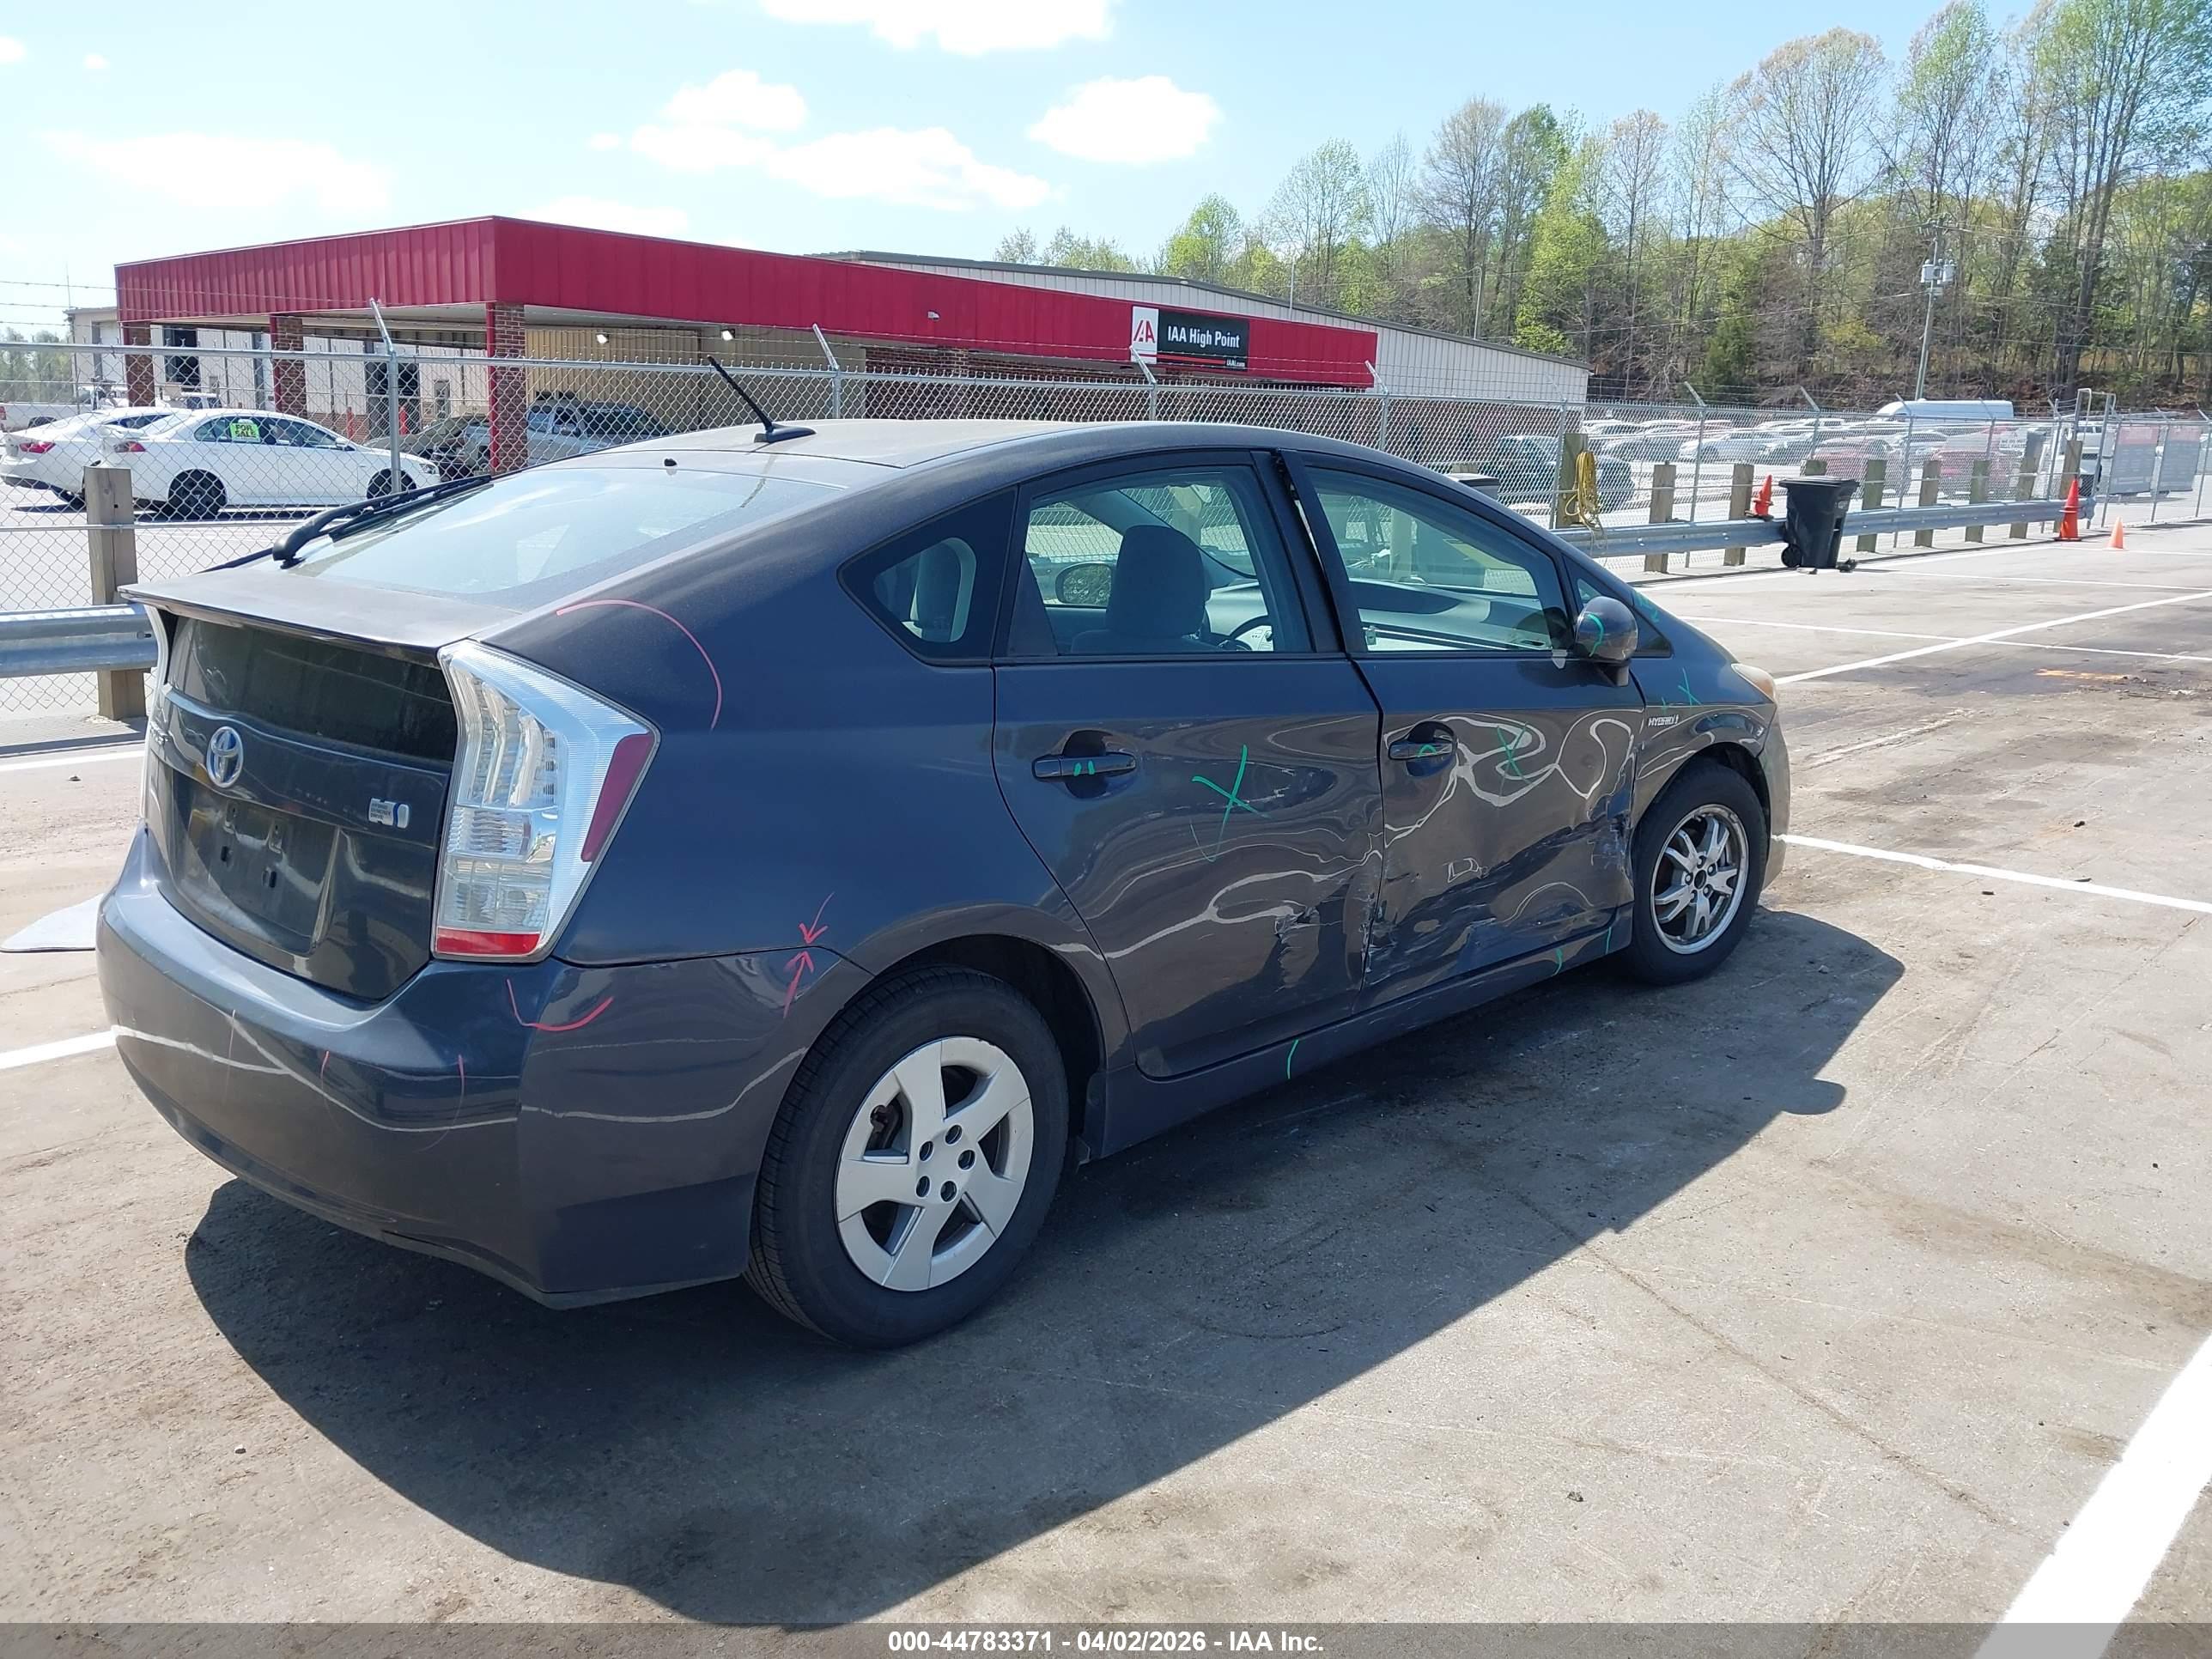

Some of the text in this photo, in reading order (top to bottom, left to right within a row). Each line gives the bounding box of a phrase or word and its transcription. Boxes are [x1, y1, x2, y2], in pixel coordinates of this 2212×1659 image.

[1167, 325, 1240, 348] IAA High Point
[235, 429, 257, 439] SALE
[1648, 715, 1674, 726] HYBRID
